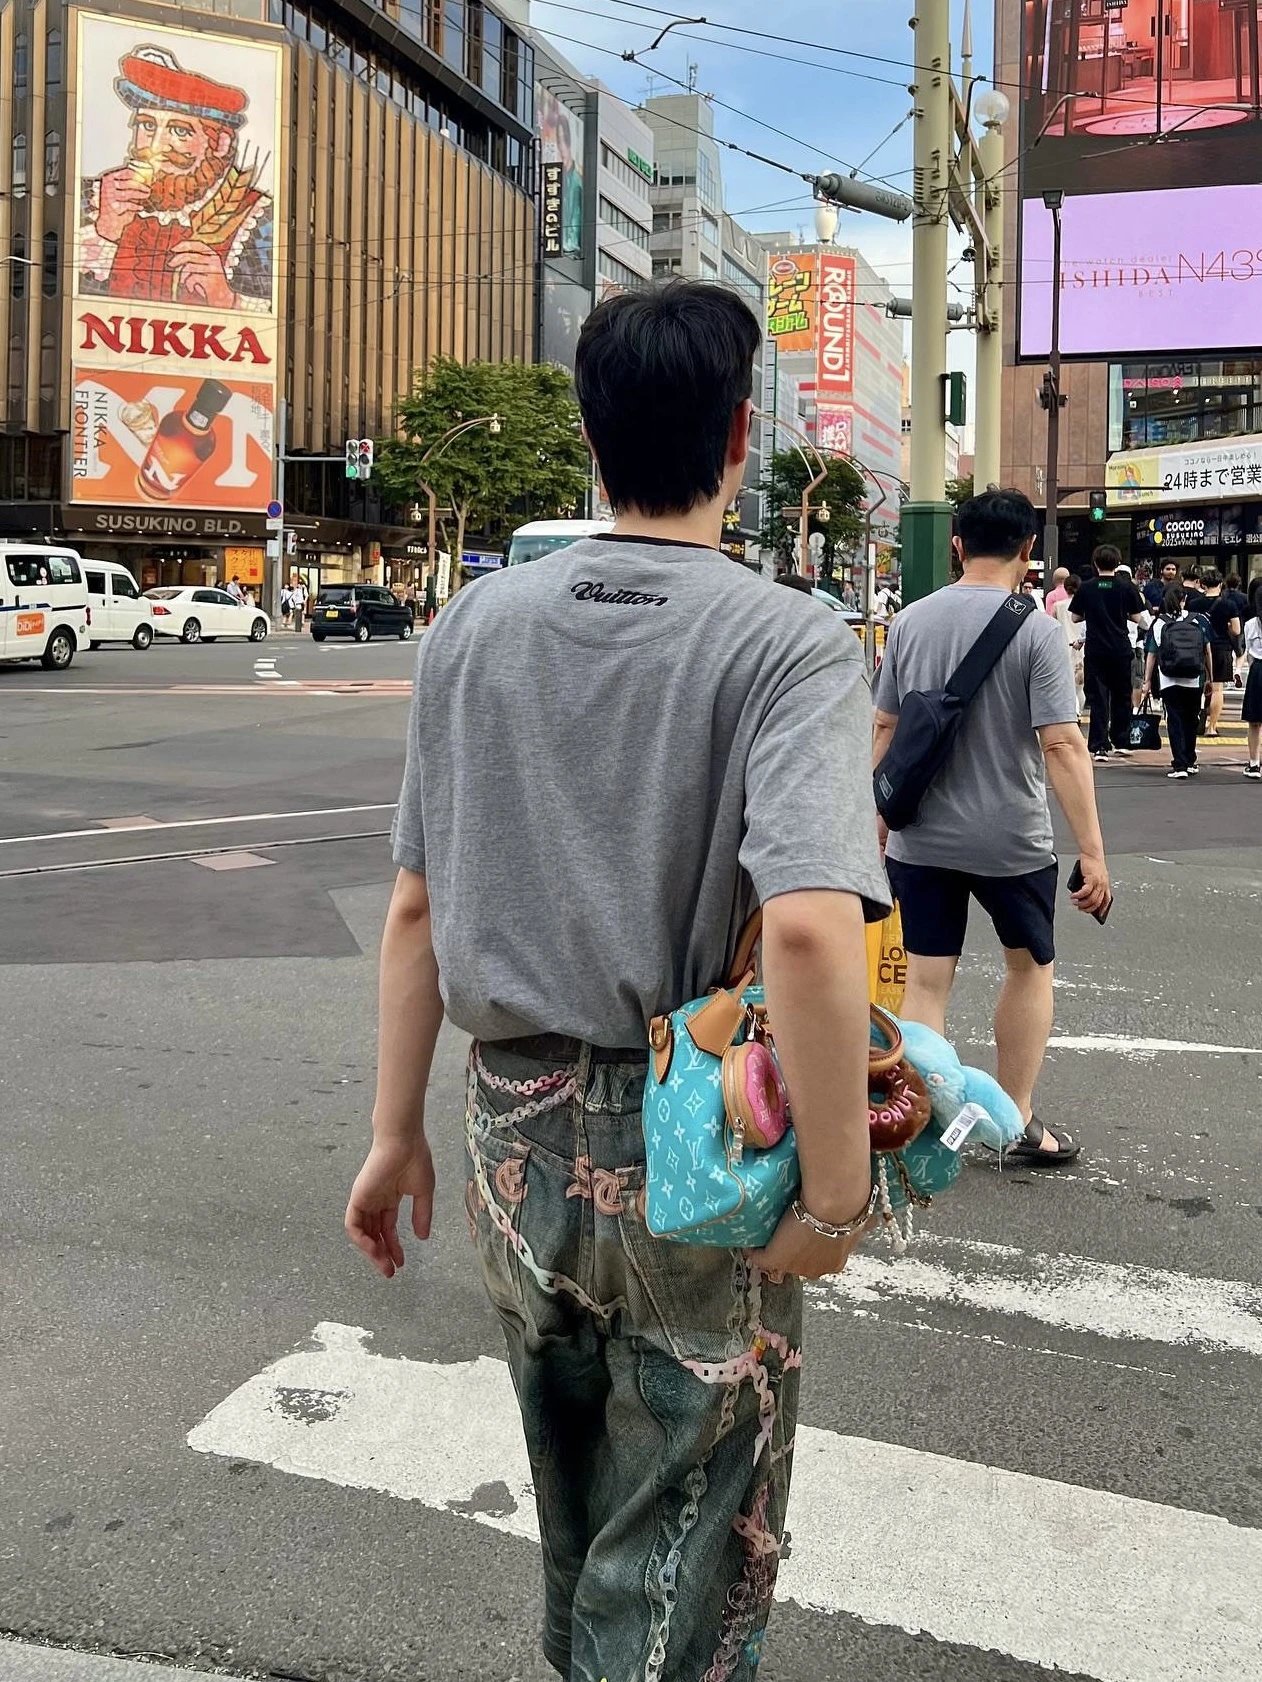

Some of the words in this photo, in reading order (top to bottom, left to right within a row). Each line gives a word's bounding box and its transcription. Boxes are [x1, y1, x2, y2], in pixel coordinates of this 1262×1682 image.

[1060, 267, 1171, 289] ISHIDA
[77, 312, 272, 364] NIKKA
[74, 390, 89, 478] FRONTIER
[93, 391, 108, 448] NIKKA
[96, 514, 197, 532] SUSUKINO
[204, 519, 247, 534] BLD.
[570, 581, 669, 606] Vuitton
